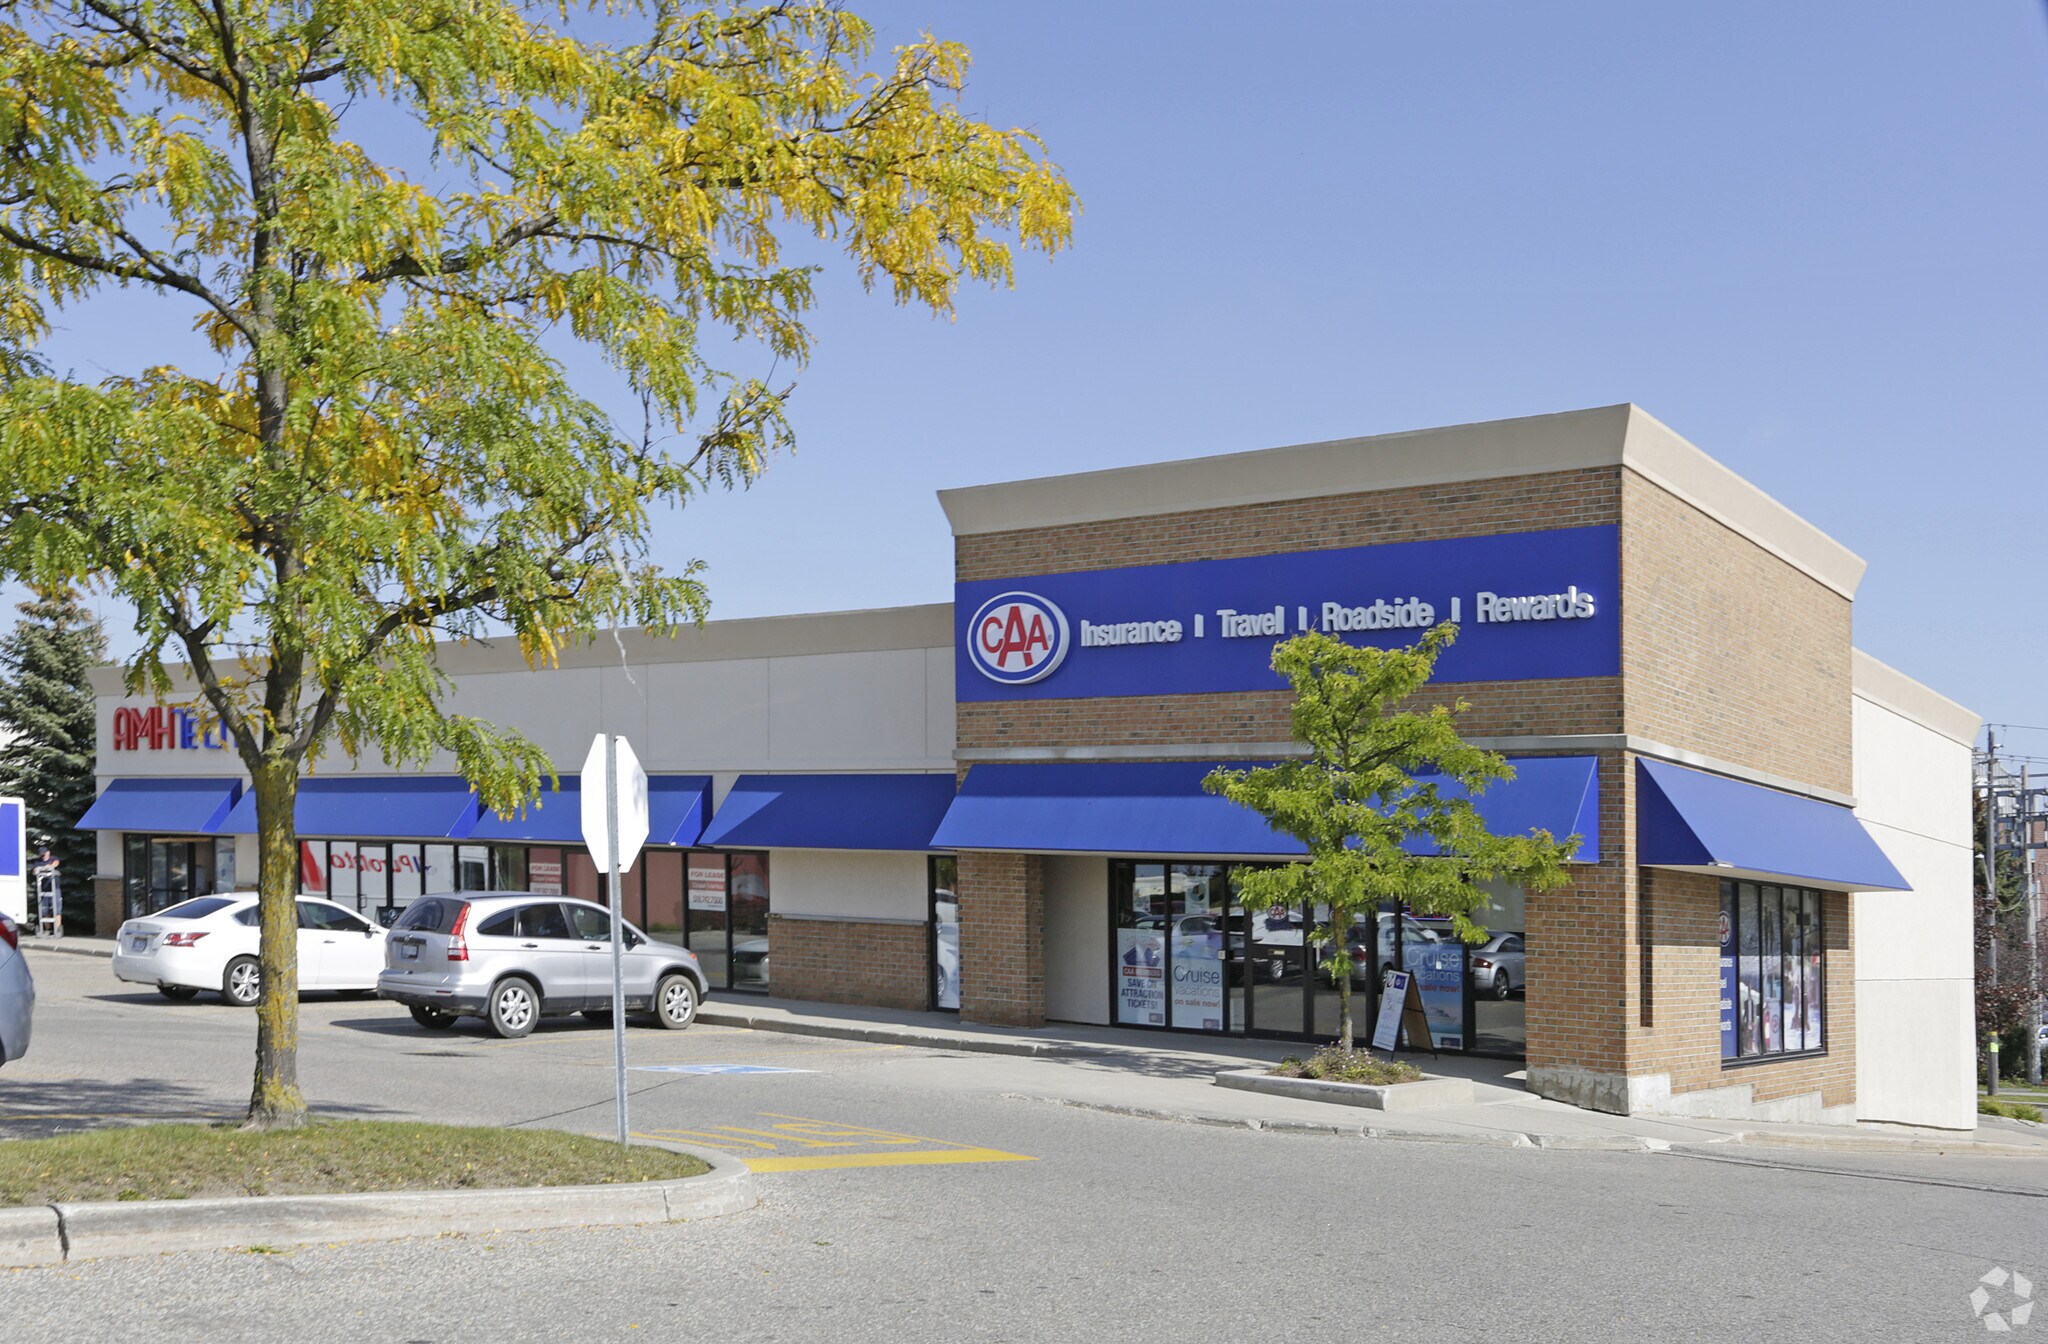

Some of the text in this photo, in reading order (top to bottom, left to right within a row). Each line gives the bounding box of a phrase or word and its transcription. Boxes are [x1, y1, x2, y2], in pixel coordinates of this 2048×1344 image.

[1080, 619, 1183, 647] Insurance
[1216, 605, 1285, 638] Travel
[1322, 597, 1434, 632] Roadside
[1476, 585, 1596, 623] Rewards
[982, 606, 1049, 667] CAA
[1405, 947, 1460, 967] Cruise
[1127, 978, 1145, 988] SAVE
[1173, 965, 1220, 984] Cruise
[1120, 988, 1164, 999] ATTRACTION
[1127, 999, 1158, 1009] TICKETS!
